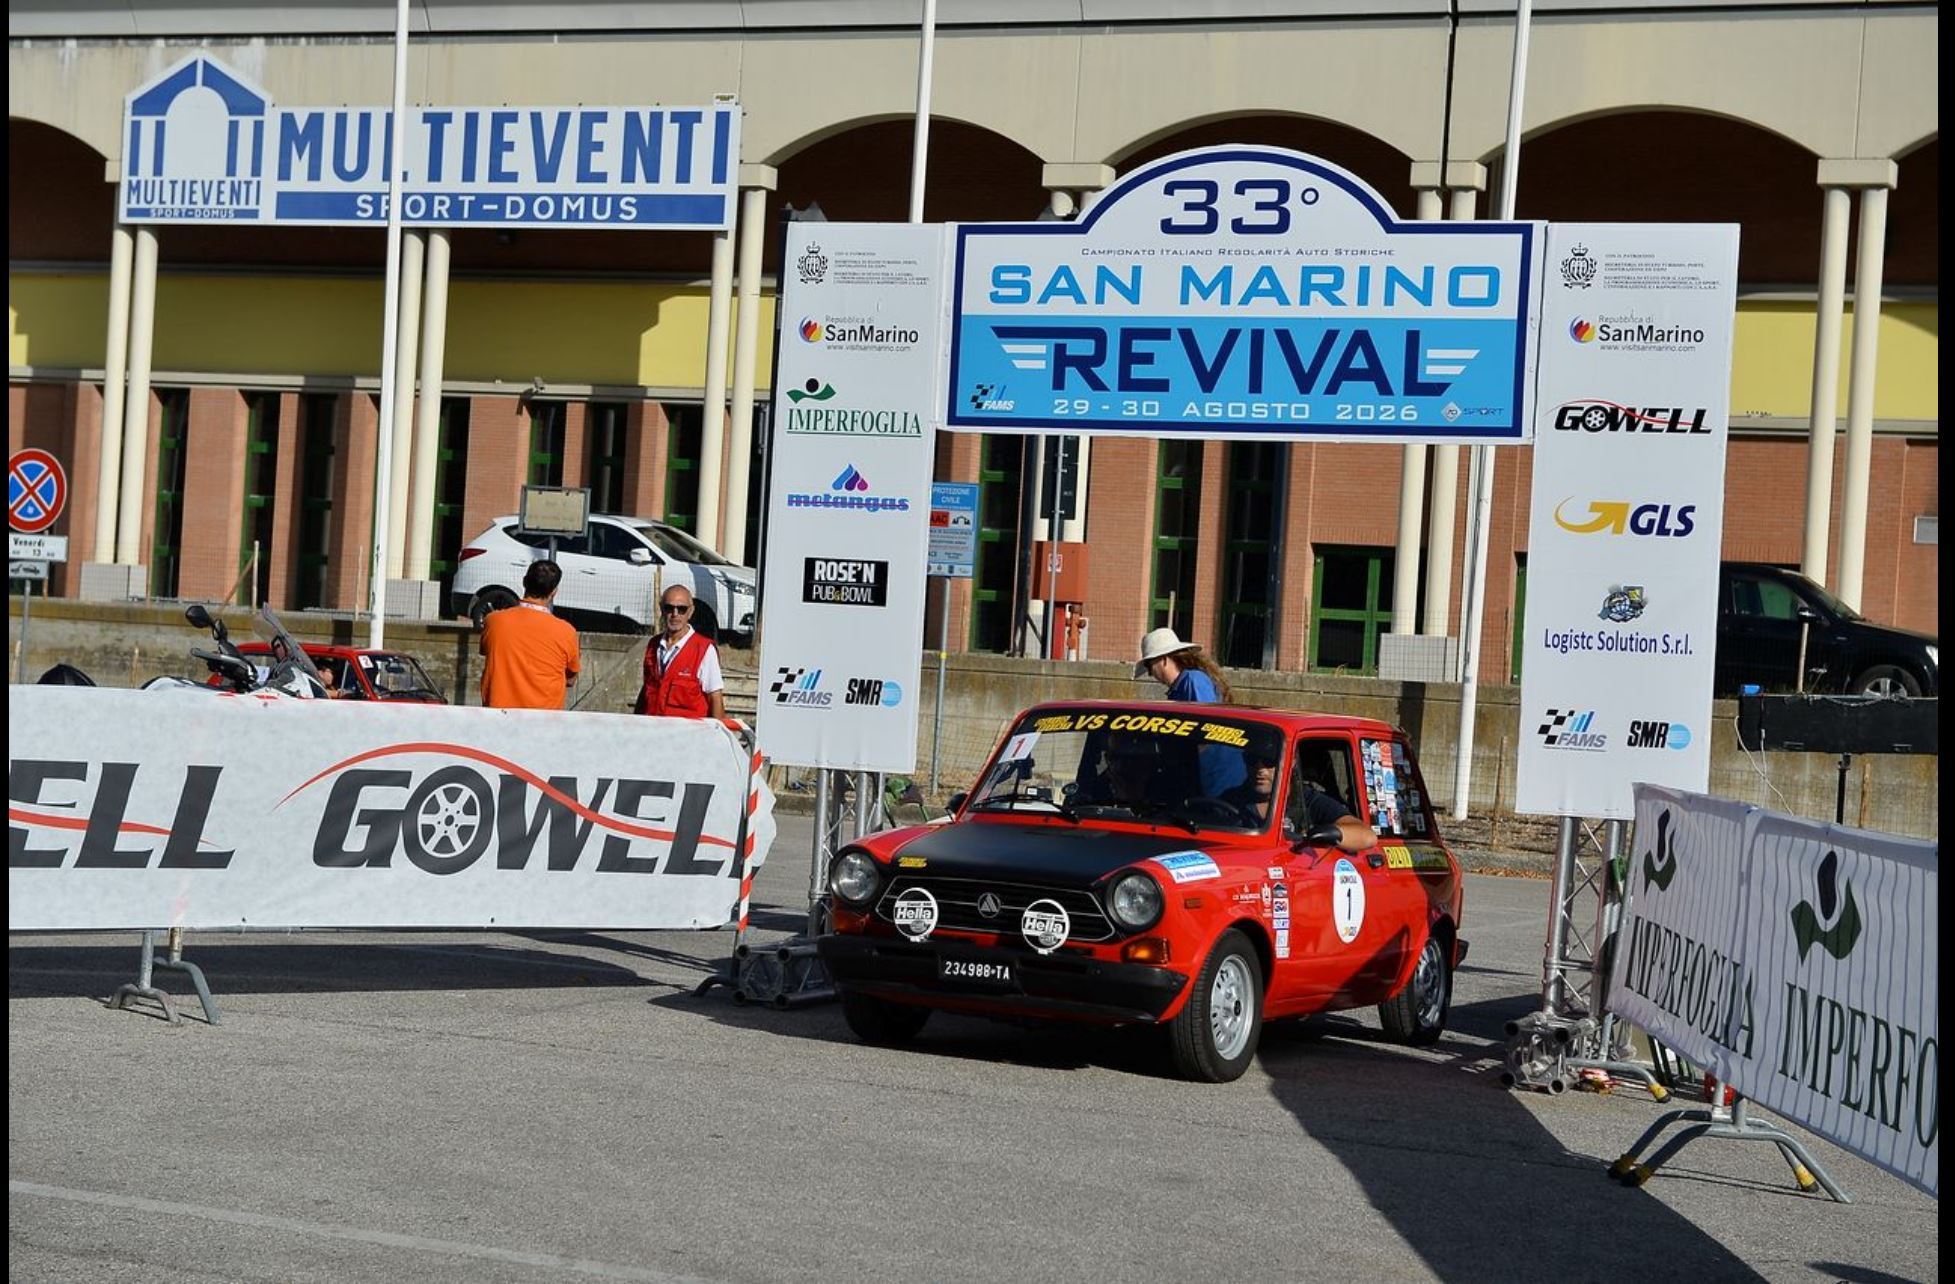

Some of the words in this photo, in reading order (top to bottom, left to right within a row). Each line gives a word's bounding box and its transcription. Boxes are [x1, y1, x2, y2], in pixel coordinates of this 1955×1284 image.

[127, 179, 261, 206] MULTIEVENTI
[149, 207, 235, 218] SPORT-DOMUS
[989, 265, 1142, 305] SAN
[1179, 265, 1500, 307] MARINO
[825, 324, 919, 343] SanMarino
[1599, 324, 1705, 343] SanMarino
[990, 325, 1453, 397] REVIVAL
[787, 407, 922, 434] IMPERFOGLIA
[1054, 399, 1090, 415] 29
[1122, 400, 1160, 416] 30
[1183, 402, 1310, 419] AGOSTO
[1336, 404, 1418, 421] 2026
[1555, 405, 1712, 434] GOWELL
[787, 493, 910, 512] metangas
[1630, 504, 1696, 537] GLS
[1597, 630, 1657, 654] Solution
[1661, 634, 1693, 655] S.r.l.
[788, 690, 833, 705] FAMS
[845, 678, 884, 706] SMR
[1074, 714, 1109, 731] VS
[1110, 715, 1200, 737] CORSE
[1627, 720, 1670, 749] SMR
[1557, 732, 1608, 748] FAMS
[896, 906, 932, 920] Hella
[1025, 915, 1064, 934] Hella
[1624, 915, 1754, 1060] IMPERFOGLIA
